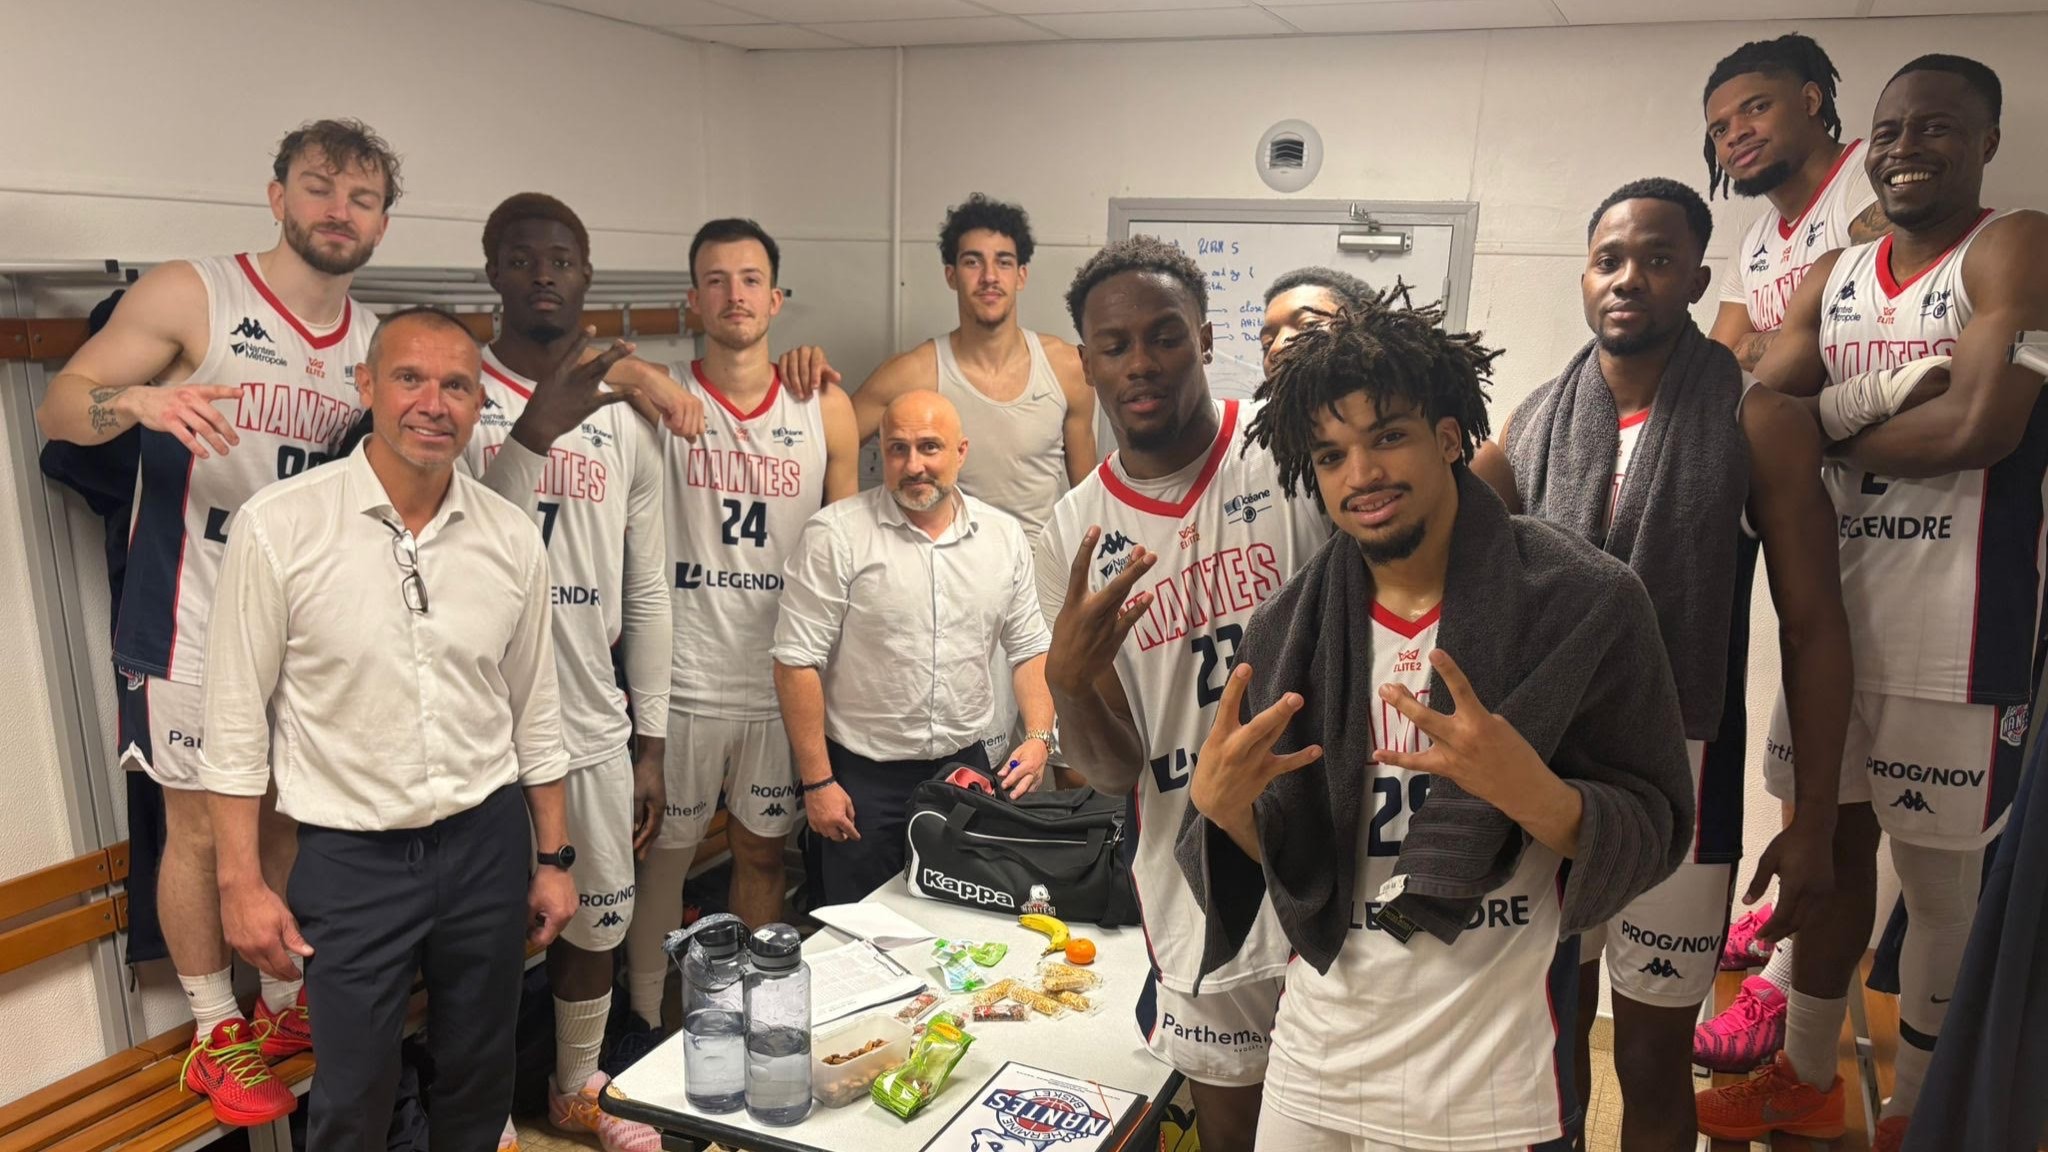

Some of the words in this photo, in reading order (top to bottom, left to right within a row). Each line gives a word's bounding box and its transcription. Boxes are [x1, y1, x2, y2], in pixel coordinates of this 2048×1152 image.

[277, 445, 328, 480] 0
[687, 448, 801, 498] NANTES
[721, 498, 768, 548] 24
[1839, 514, 1953, 540] EGENDRE
[551, 586, 600, 606] ENDR
[706, 570, 784, 590] LEGEND
[1865, 756, 1986, 788] PROG/NOV
[750, 784, 796, 799] ROG/N
[578, 884, 636, 908] ROG/NO
[923, 867, 1015, 909] Kappa
[1349, 894, 1531, 932] LEDRE
[1621, 919, 1721, 954] PROG/NOV
[988, 1092, 1104, 1138] NANTES
[1030, 1090, 1086, 1109] BASKET
[1001, 1116, 1065, 1141] HERMINE
